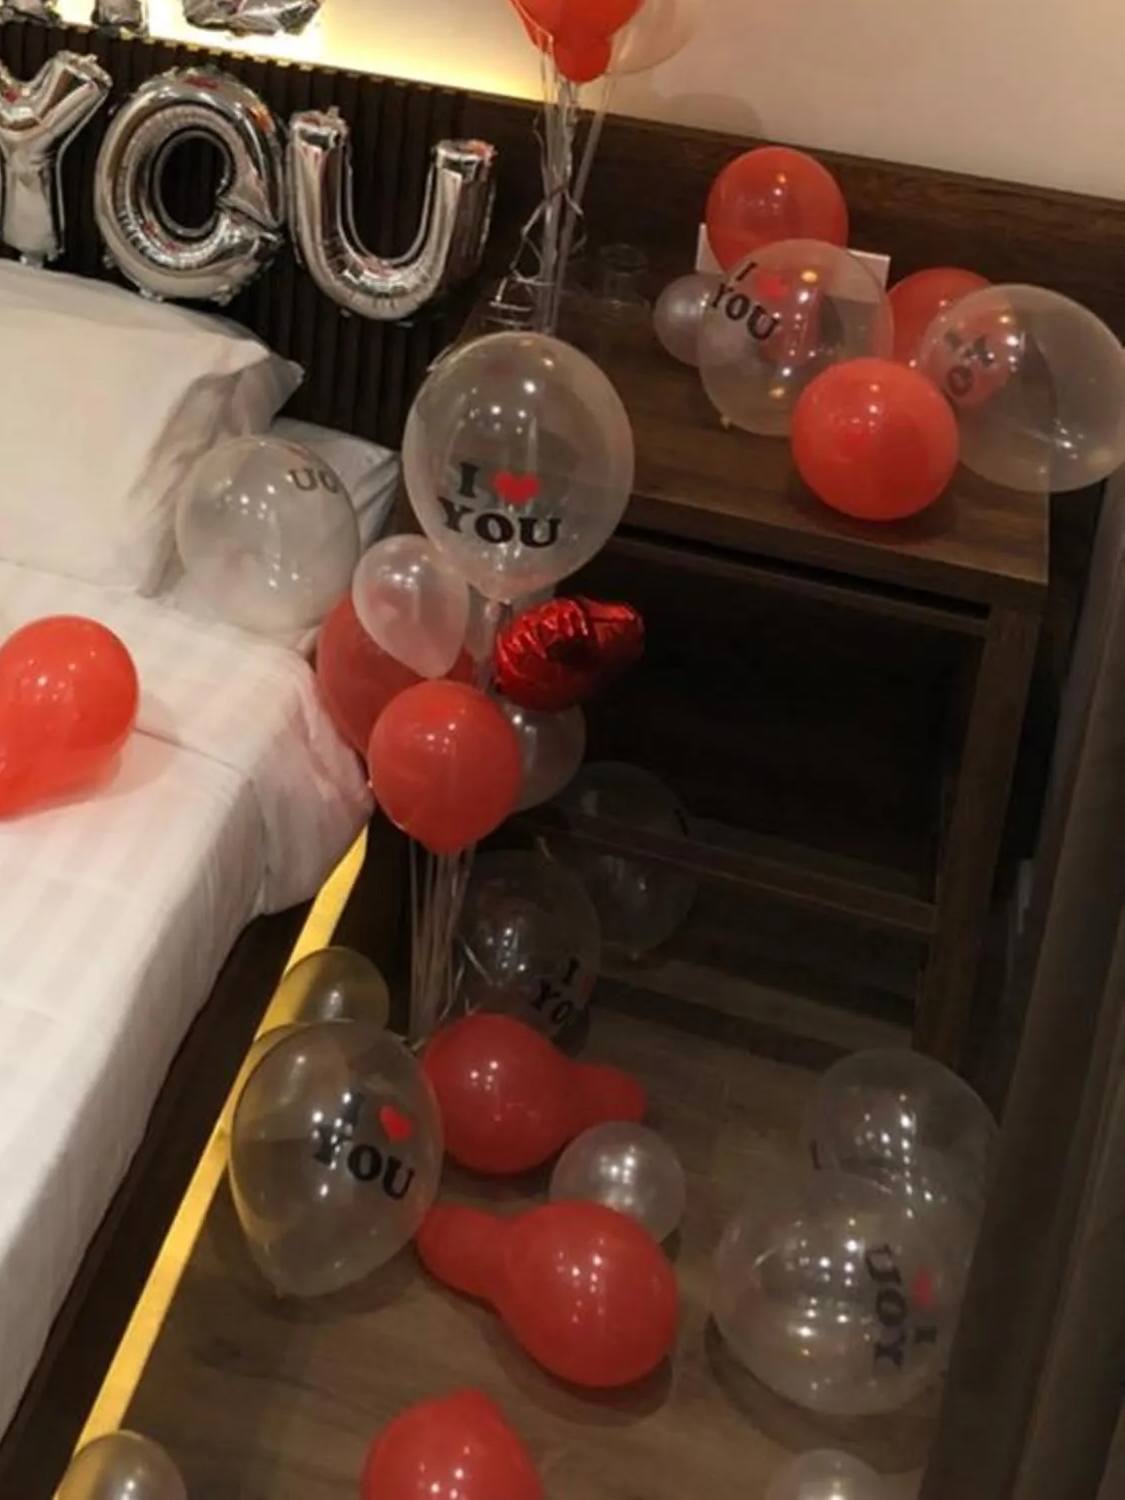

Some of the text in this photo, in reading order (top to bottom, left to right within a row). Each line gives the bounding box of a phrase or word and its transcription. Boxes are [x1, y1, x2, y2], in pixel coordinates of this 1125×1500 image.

[735, 260, 760, 283] I
[710, 280, 780, 342] YOU
[456, 462, 481, 499] I
[437, 495, 563, 549] YOU
[312, 1124, 416, 1201] YOU
